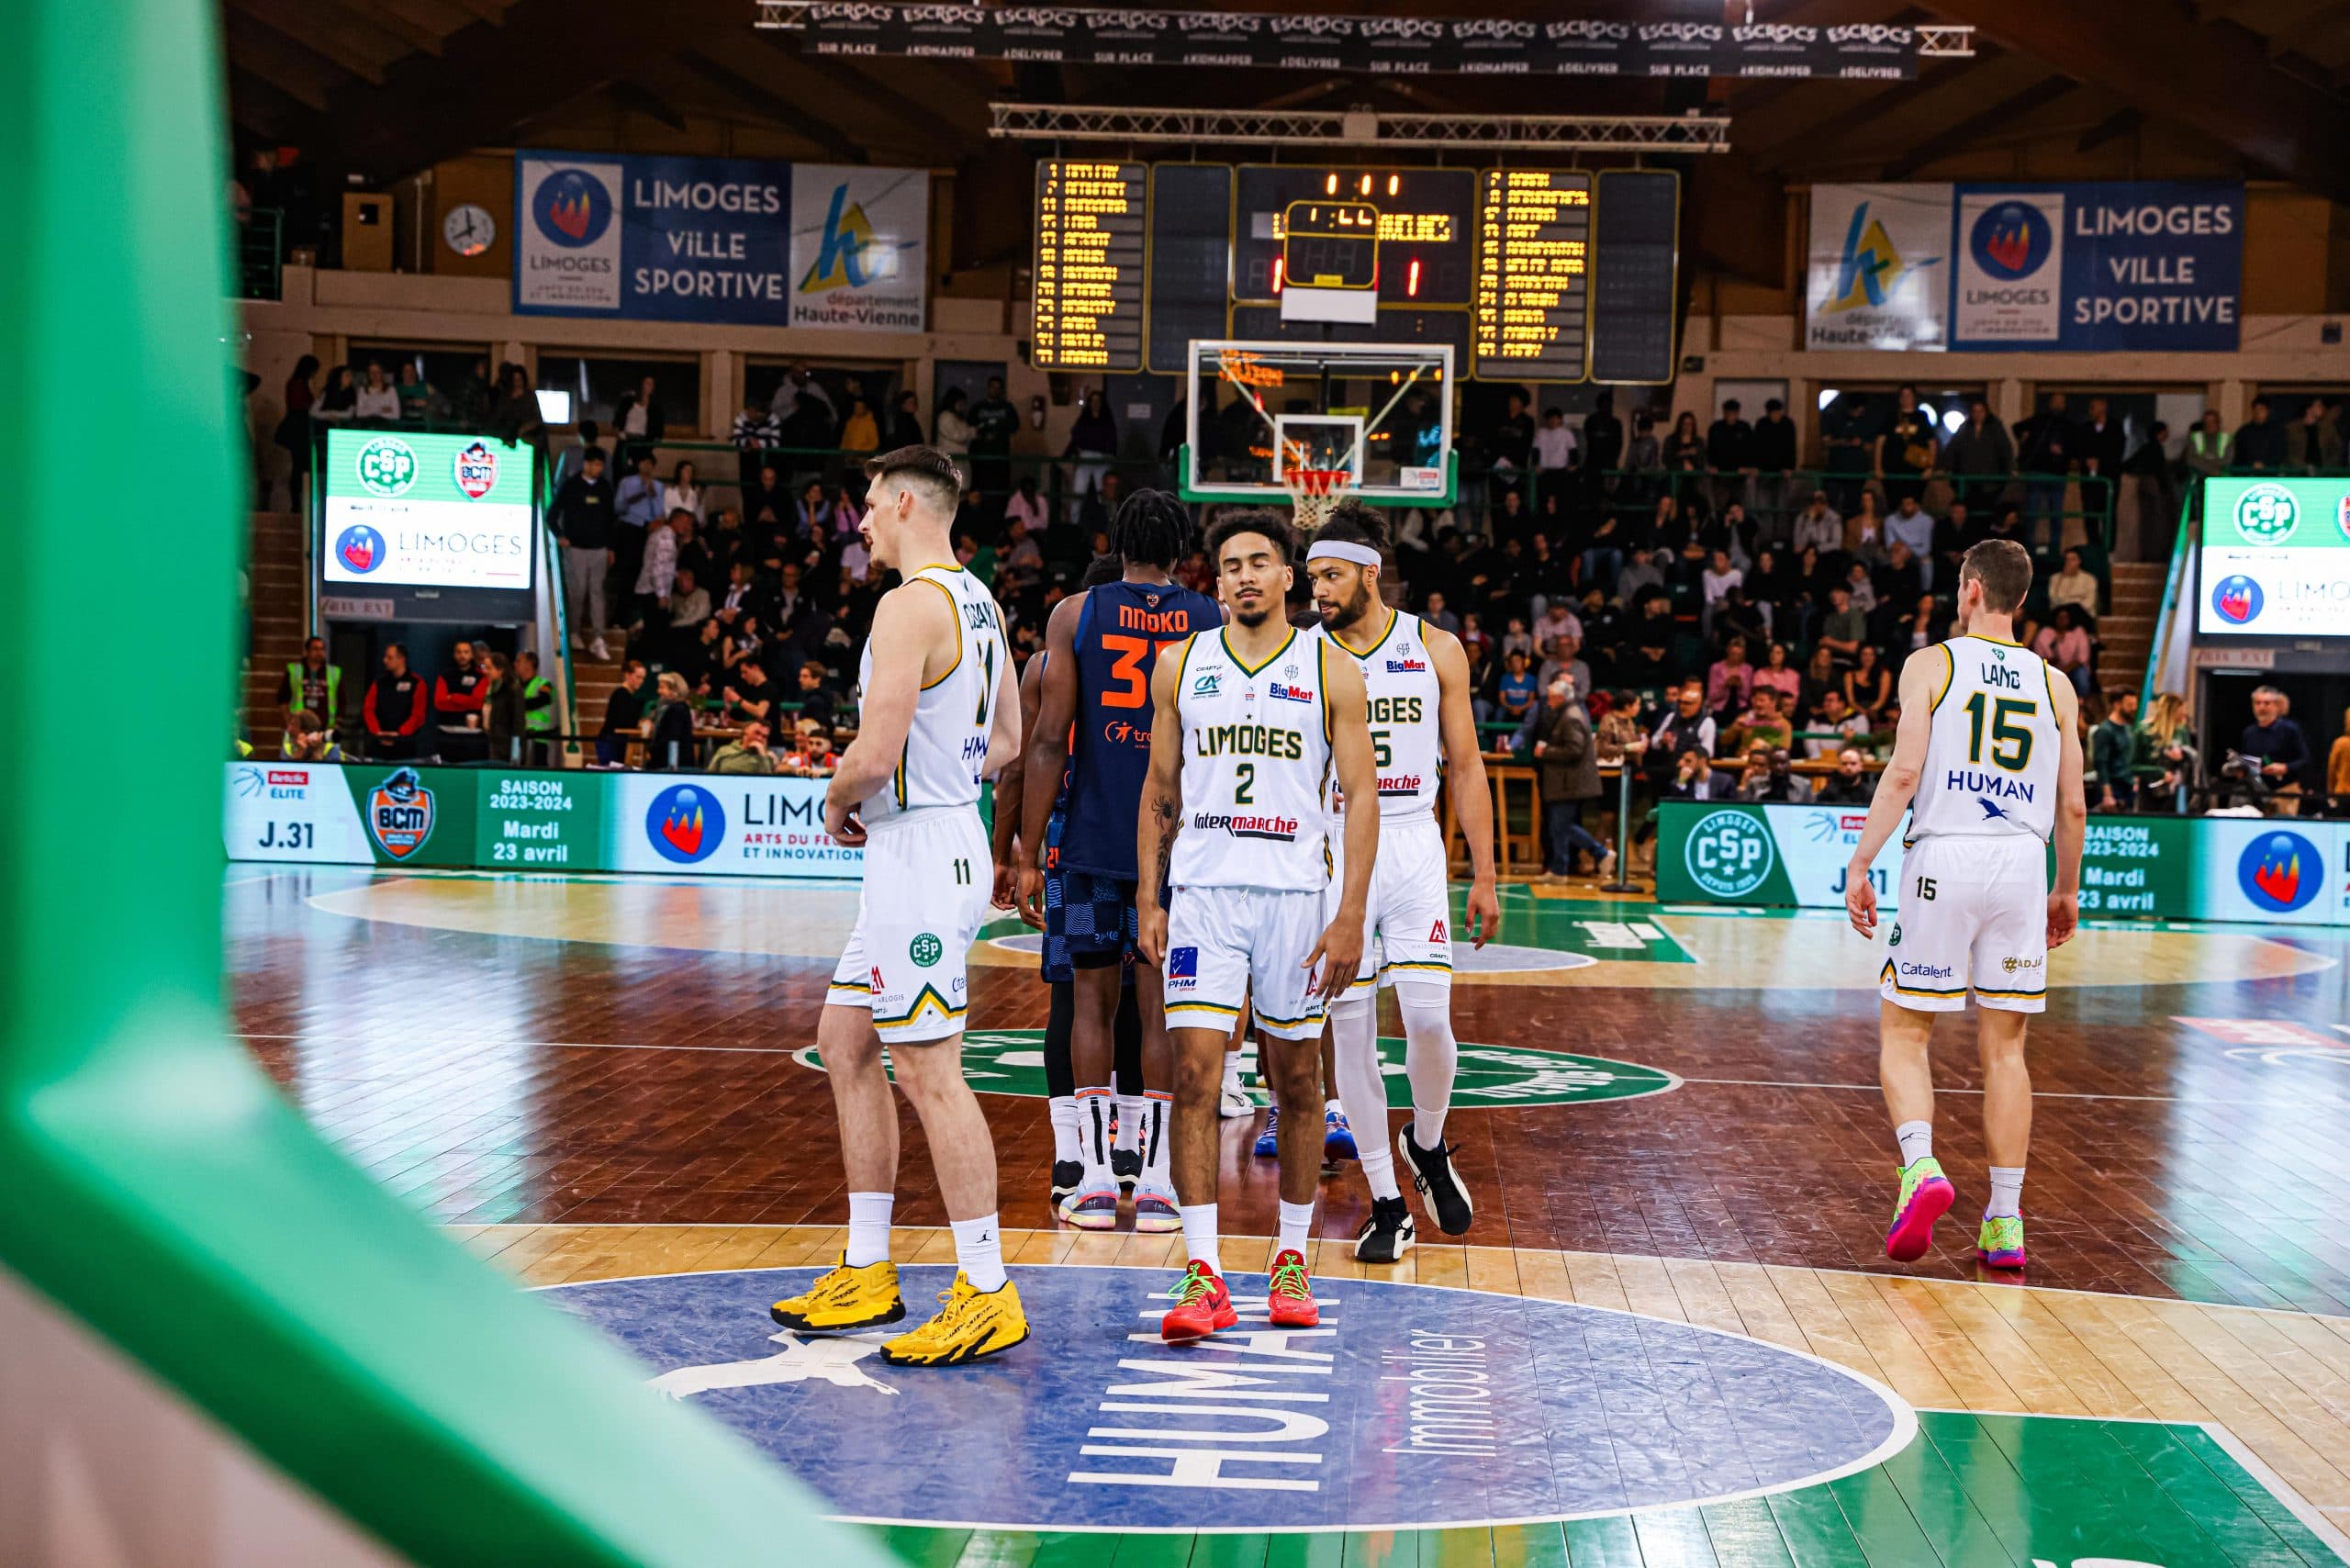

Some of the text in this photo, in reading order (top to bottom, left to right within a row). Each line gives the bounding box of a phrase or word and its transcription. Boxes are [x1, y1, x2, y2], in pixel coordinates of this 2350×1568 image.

[811, 3, 893, 21] ESCROCS
[902, 6, 985, 24] ESCROCS
[994, 7, 1077, 27] ESCROCS
[1087, 12, 1168, 28] ESCROCS
[1179, 14, 1259, 31] ESCROCS
[1270, 16, 1352, 34] ESCROCS
[1360, 18, 1442, 38] ESCROCS
[1453, 19, 1535, 39] ESCROCS
[1546, 20, 1628, 39] ESCROCS
[1639, 22, 1723, 40] ESCROCS
[1732, 24, 1818, 43] ESCROCS
[1827, 25, 1911, 44] ESCROCS
[843, 43, 877, 54] PLACE
[1119, 52, 1154, 64] PLACE
[1395, 62, 1429, 73] PLACE
[1674, 65, 1710, 76] PLACE
[634, 180, 780, 213] LIMOGES
[2076, 206, 2232, 235] LIMOGES
[667, 230, 745, 259] VILLE
[530, 256, 611, 274] LIMOGES
[2109, 256, 2195, 284] VILLE
[634, 268, 783, 300] SPORTIVE
[1965, 288, 2050, 305] LIMOGES
[794, 306, 920, 327] Haute-Vienne
[2074, 296, 2235, 324] SPORTIVE
[364, 450, 410, 479] CSP
[2242, 495, 2292, 527] CSP
[399, 532, 522, 555] LIMOGES
[2278, 580, 2350, 601] LIMO
[1386, 659, 1426, 673] BigMat
[1981, 662, 2020, 689] LANG
[1270, 682, 1314, 700] BigMat
[1962, 689, 2039, 774] 15
[1194, 724, 1303, 761] LIMOGES
[500, 780, 564, 797] SAISON
[1235, 762, 1256, 805] 2
[1947, 769, 2034, 804] HUMAN
[490, 794, 573, 811] 2023-2024
[379, 807, 424, 830] BCM
[259, 821, 314, 848] J.31
[503, 820, 560, 840] Mardi
[744, 834, 782, 845] ARTS
[788, 834, 809, 846] DU
[2085, 825, 2149, 841] SAISON
[493, 844, 569, 863] 23 avril
[744, 847, 864, 861] ET INNOVATION
[1697, 828, 1762, 870] CSP
[2083, 840, 2160, 857] 023-2024
[954, 858, 971, 884] 11
[2086, 866, 2145, 888] Mardi
[1916, 875, 1938, 902] 15
[2077, 890, 2154, 911] 23 avril
[913, 939, 938, 958] CSP
[1901, 962, 1952, 979] Catalent
[1169, 979, 1197, 989] PHM
[1067, 1293, 1341, 1492] HUMAN
